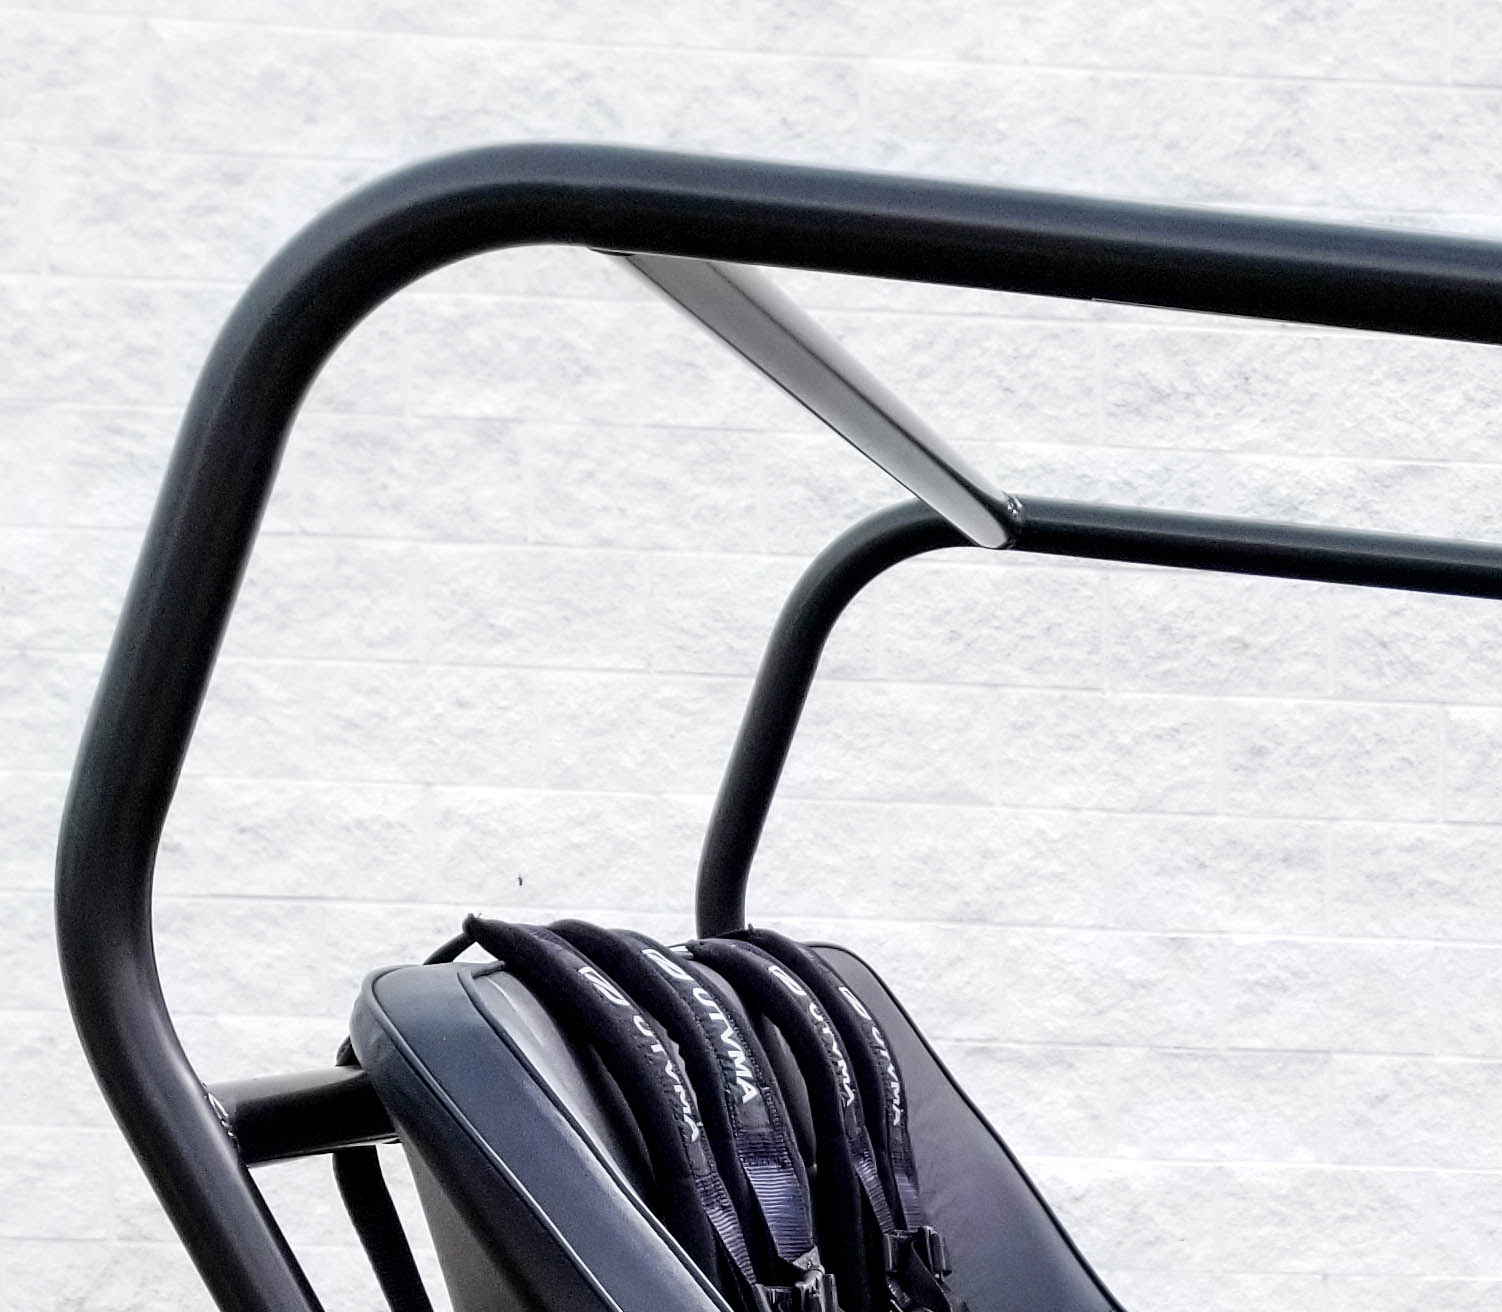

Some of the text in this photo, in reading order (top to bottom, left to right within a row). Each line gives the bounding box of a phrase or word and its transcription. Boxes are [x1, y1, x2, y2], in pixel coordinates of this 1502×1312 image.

[633, 1015, 700, 1143] UTVMA
[692, 987, 758, 1105] UTVMA
[809, 1002, 855, 1107] UTVMA
[872, 1026, 901, 1126] UTVMA
